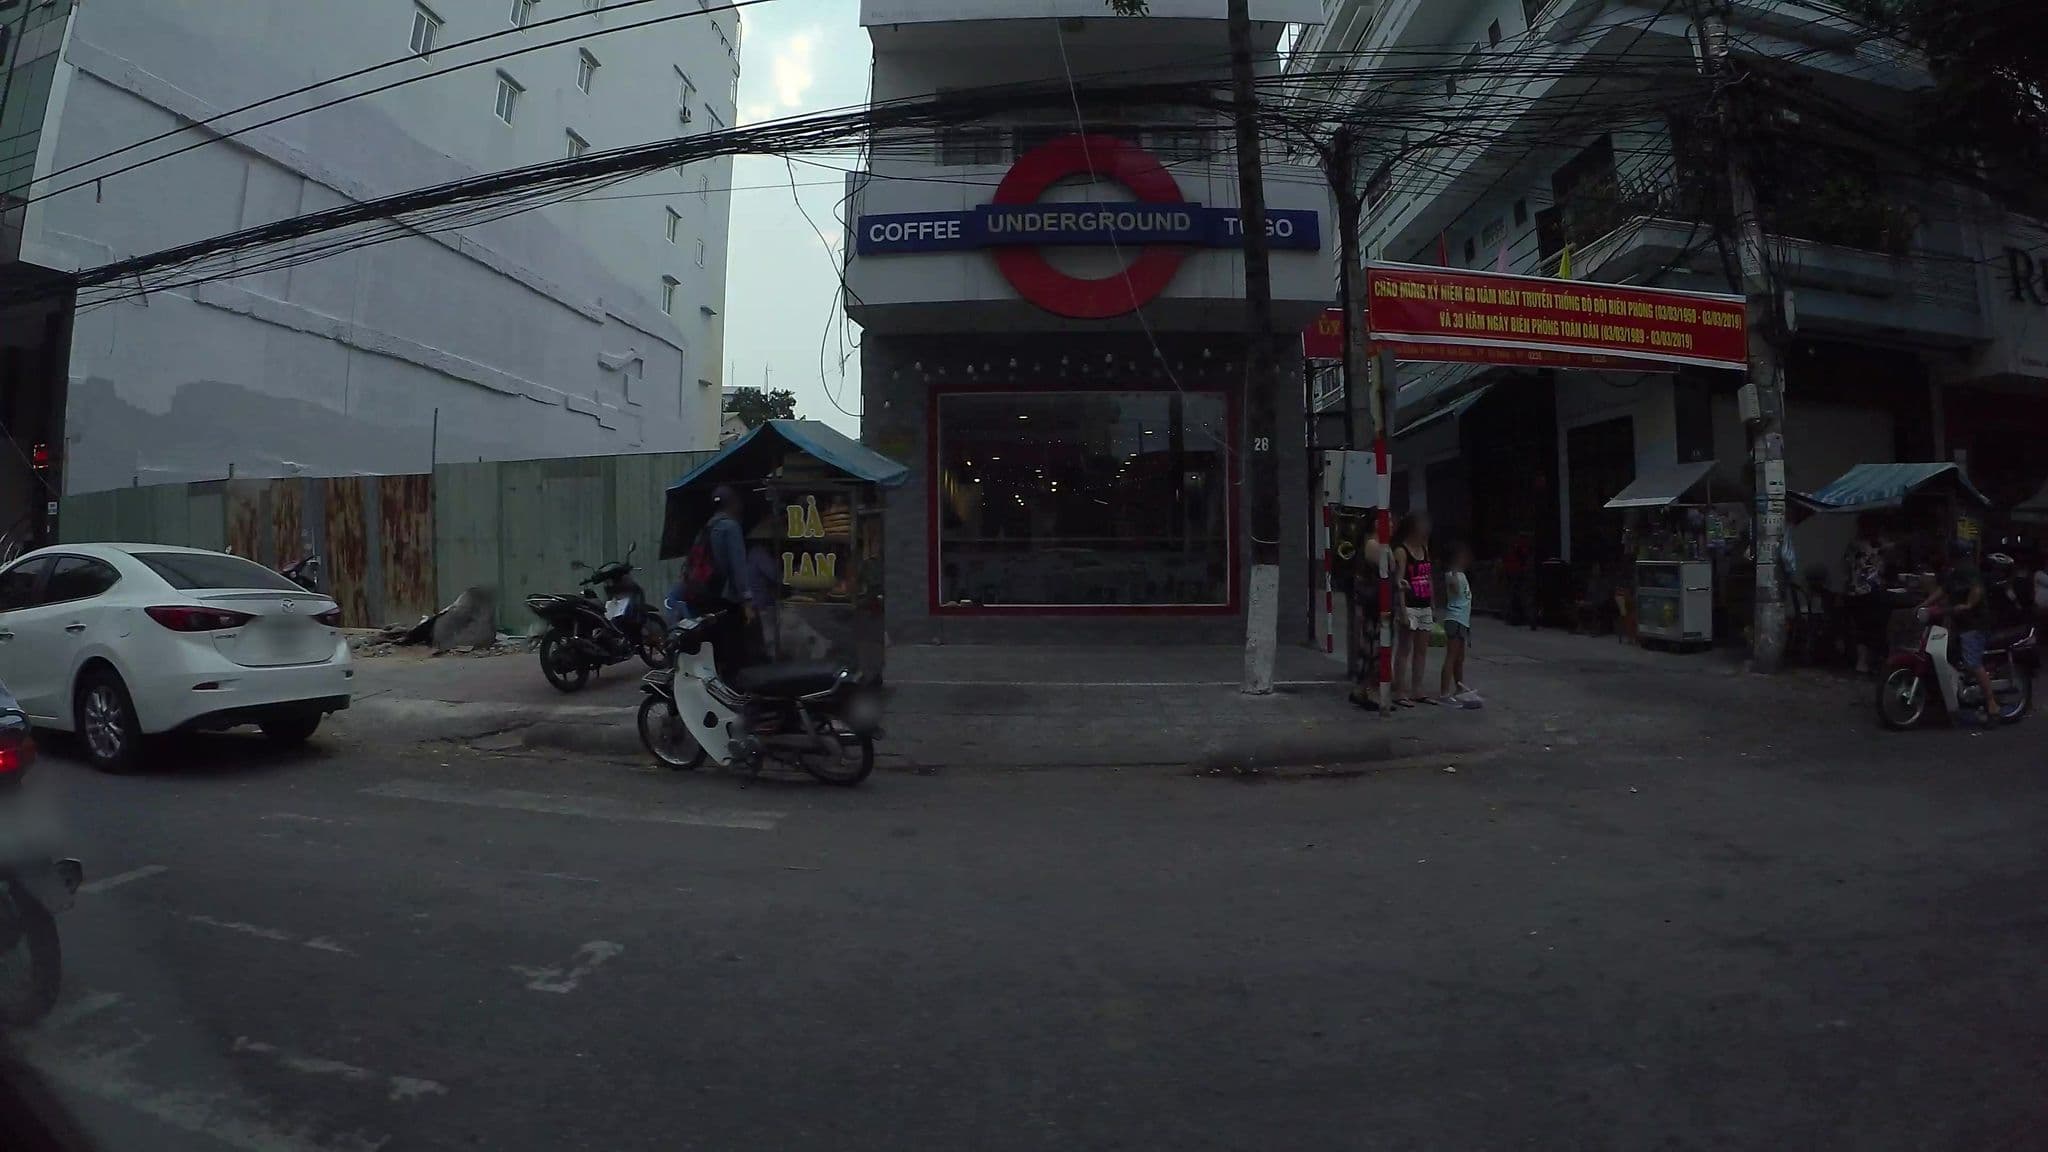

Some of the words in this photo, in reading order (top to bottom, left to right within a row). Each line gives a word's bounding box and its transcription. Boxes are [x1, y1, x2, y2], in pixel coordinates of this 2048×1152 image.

[869, 220, 961, 243] COFFEE
[987, 211, 1191, 233] UNDERGROUND
[1374, 277, 1398, 297] CHÀO
[1400, 279, 1426, 299] MỪNG
[1427, 280, 1439, 300] KỶ
[1440, 282, 1462, 304] NIỆM
[1464, 286, 1476, 303] 60
[1476, 285, 1497, 304] NĂM
[1498, 288, 1520, 307] NGÀY
[1521, 288, 1553, 309] TRUYỀN
[1554, 290, 1580, 311] THỐNG
[1581, 294, 1593, 316] BỘ
[1593, 296, 1607, 317] ĐỘI
[1608, 297, 1627, 316] BIÊN
[1628, 299, 1654, 319] PHÒNG
[1702, 310, 1742, 331] 03/03/2019)
[1439, 308, 1452, 328] VÀ
[1452, 312, 1464, 329] 30
[1465, 311, 1485, 330] NĂM
[1487, 312, 1509, 332] NGÀY
[1510, 314, 1530, 333] BIÊN
[1531, 315, 1559, 336] PHÒNG
[1560, 318, 1581, 338] TOÀN
[1583, 320, 1599, 339] DÂN
[1651, 329, 1693, 350] 03/03/2019)
[782, 551, 836, 586] LAN
